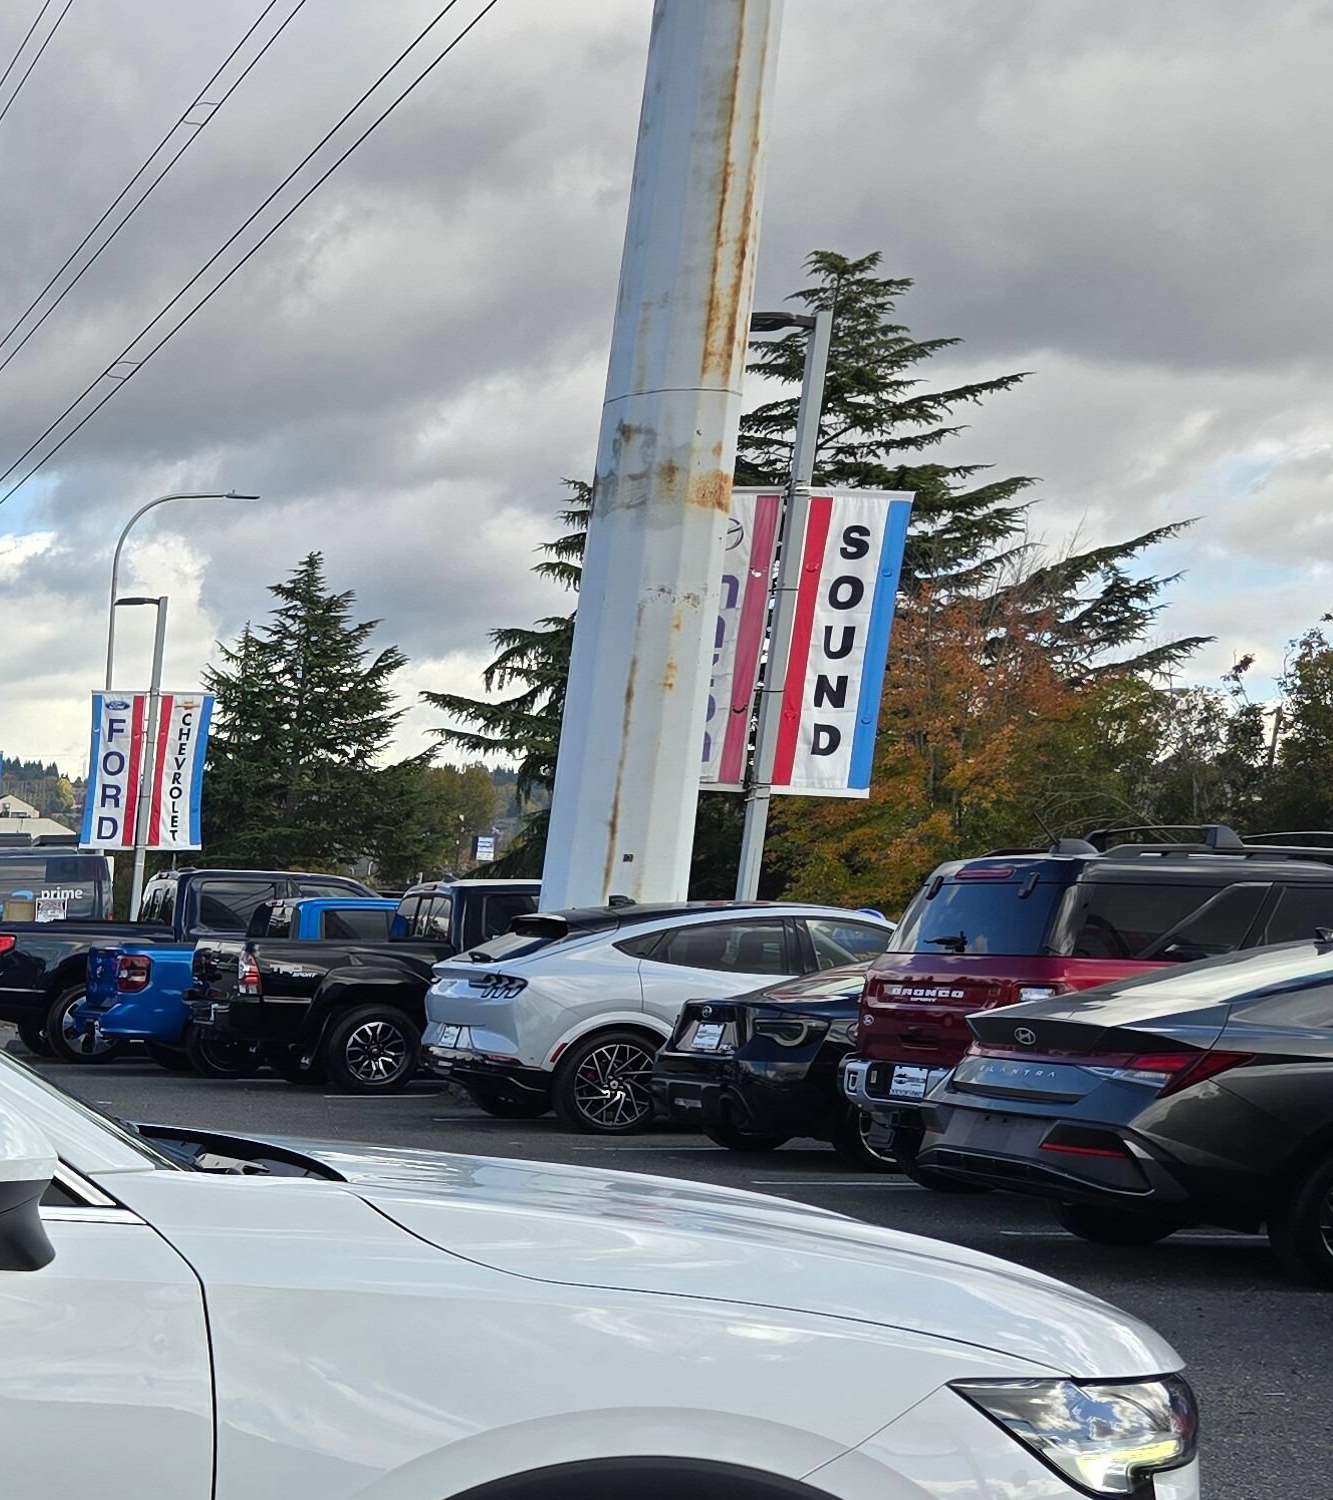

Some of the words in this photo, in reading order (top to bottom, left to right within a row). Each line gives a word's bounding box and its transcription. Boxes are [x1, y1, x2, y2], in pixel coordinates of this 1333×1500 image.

[811, 525, 871, 757] SOUND
[96, 718, 126, 840] FORD
[169, 713, 193, 842] CHEVROLET
[41, 886, 83, 899] prime
[891, 987, 964, 998] BRONCO
[979, 1065, 1055, 1078] ELANTRA
